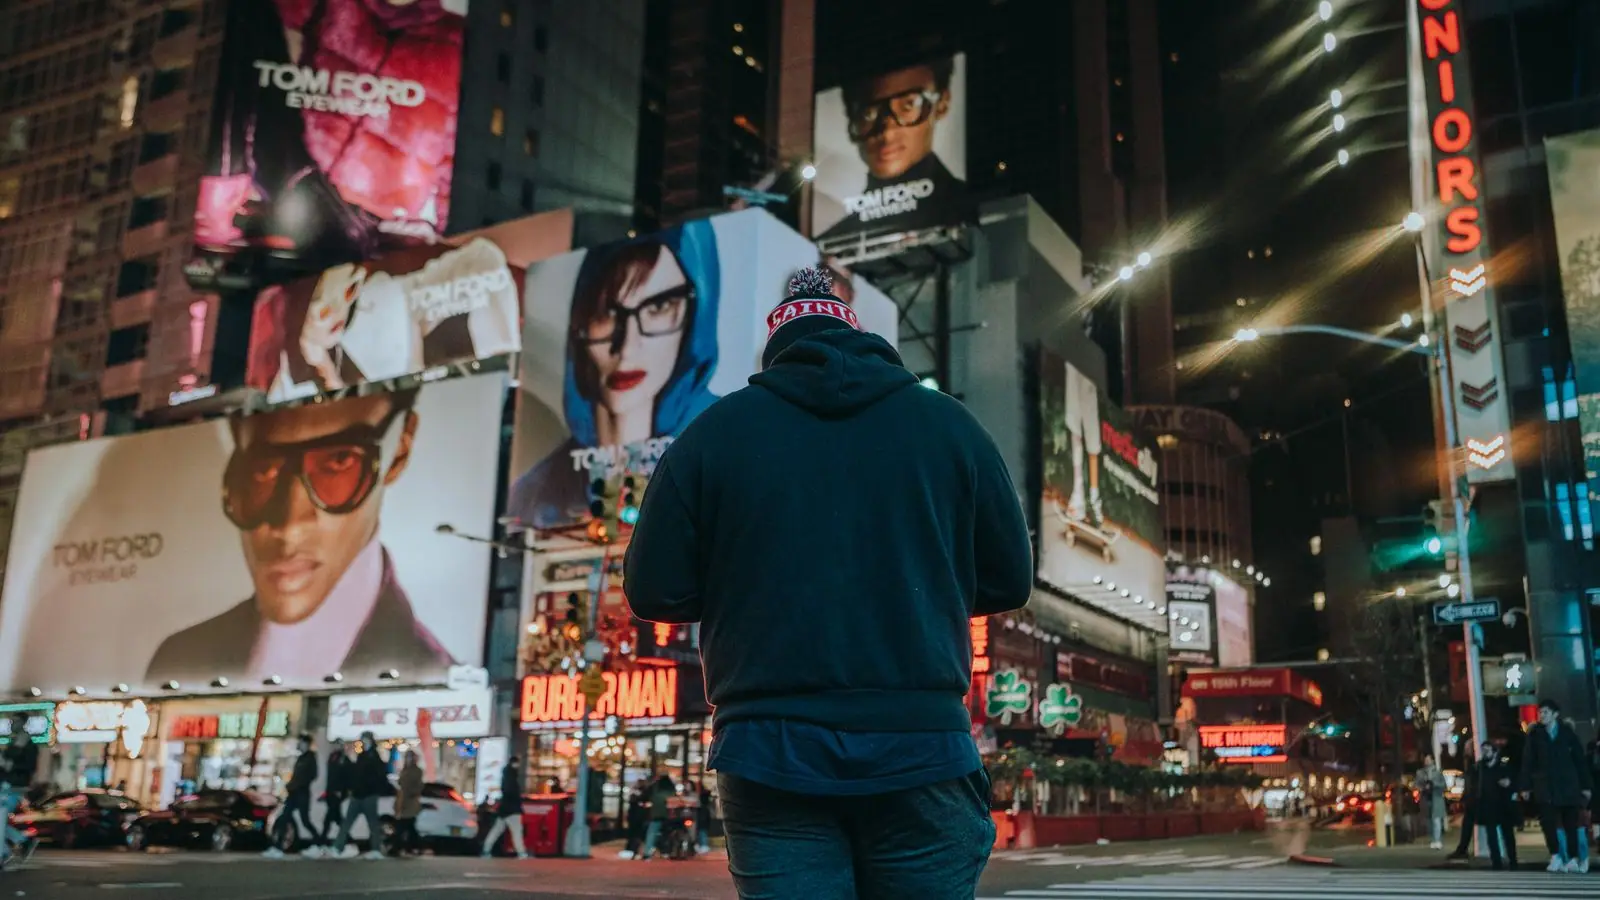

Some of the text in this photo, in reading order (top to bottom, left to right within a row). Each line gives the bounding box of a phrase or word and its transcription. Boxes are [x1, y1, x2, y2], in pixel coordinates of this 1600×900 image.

[252, 59, 426, 107] TOM FORD
[285, 91, 391, 119] EYEWEAR
[1418, 0, 1481, 254] NIORS
[844, 178, 934, 214] TOM FORD
[410, 268, 509, 311] TOM FORD
[53, 532, 164, 567] TOM FORD
[522, 668, 677, 721] BURGRMAN
[1240, 676, 1275, 688] Floor
[1200, 732, 1224, 747] THE
